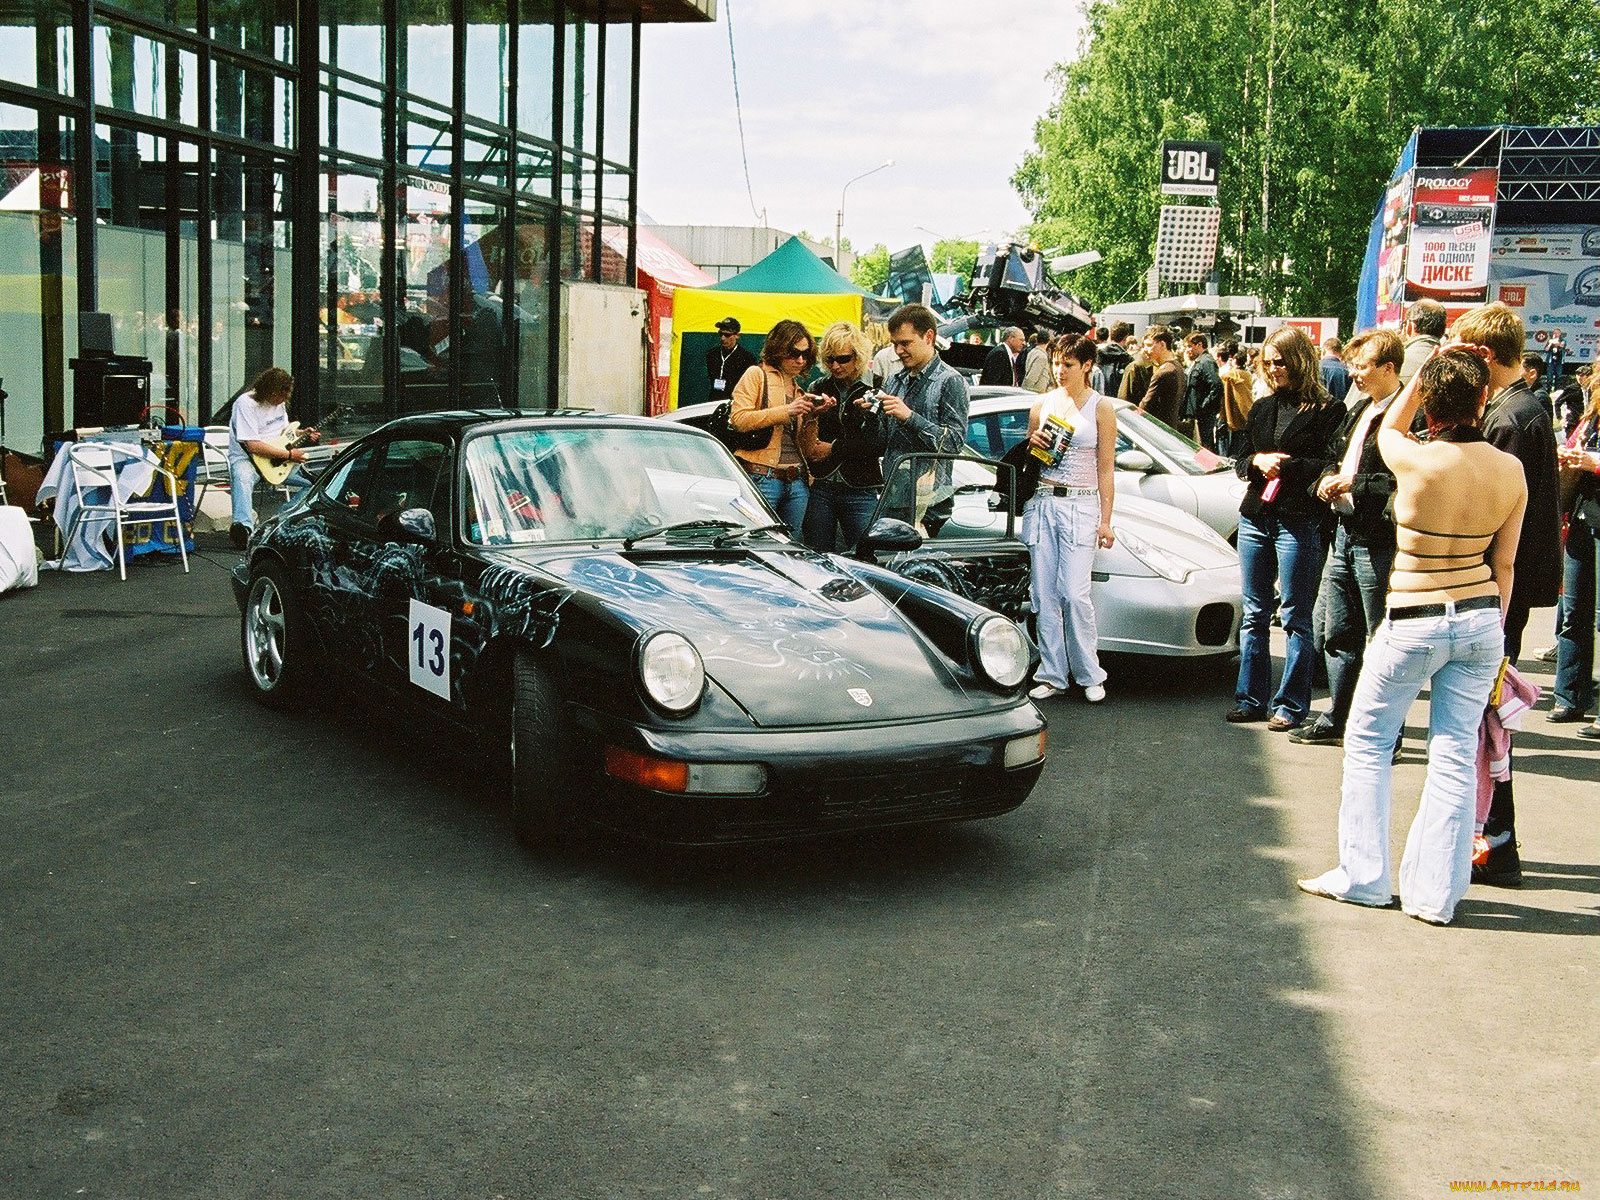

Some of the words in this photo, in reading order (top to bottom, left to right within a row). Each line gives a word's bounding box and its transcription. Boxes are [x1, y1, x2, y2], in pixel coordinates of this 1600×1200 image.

[1168, 150, 1215, 181] JBL
[1416, 177, 1472, 190] PROLOGY
[1455, 223, 1480, 235] USB
[1424, 242, 1446, 251] 1000
[1448, 242, 1476, 251] ПЕСЕН
[1422, 253, 1435, 262] НА
[1439, 253, 1474, 264] ОДНОМ
[1421, 266, 1473, 283] ДИСКЕ
[1504, 291, 1521, 301] JBL
[1543, 314, 1587, 323] Rambler
[413, 622, 445, 676] 13
